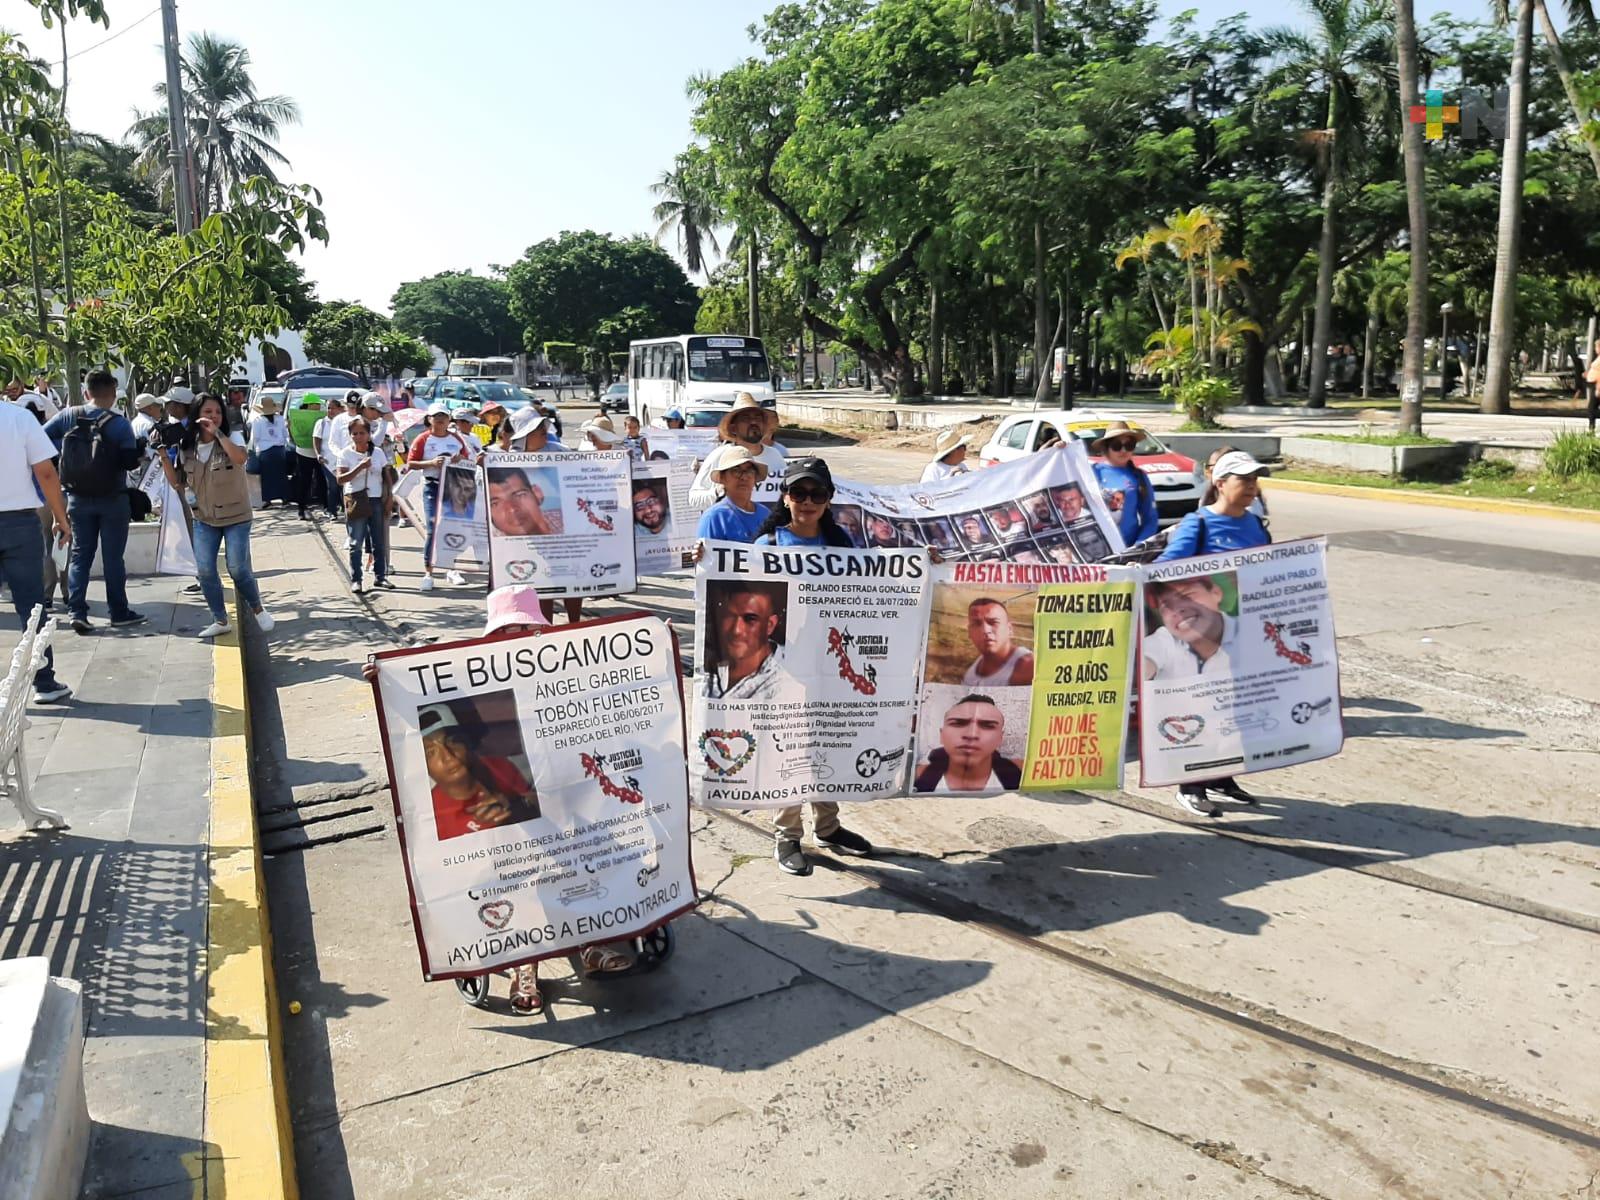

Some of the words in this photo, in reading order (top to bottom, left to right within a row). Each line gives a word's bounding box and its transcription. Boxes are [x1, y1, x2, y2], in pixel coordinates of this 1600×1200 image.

[713, 548, 749, 573] TE
[763, 552, 923, 578] BUSCAMOS
[954, 563, 1002, 582] HASTA
[1006, 564, 1108, 583] ENCONTRARTE
[1223, 559, 1231, 569] A
[1260, 573, 1285, 586] JUAN
[1287, 568, 1317, 581] PABLO
[798, 584, 840, 592] ORLANDO
[841, 584, 877, 593] ESTRADA
[1242, 587, 1282, 603] BADILLO
[798, 596, 861, 606] DESAPARECIÓ
[863, 597, 874, 605] EL
[1037, 594, 1083, 614] TOMAS
[1087, 593, 1133, 612] ELVIRA
[819, 610, 830, 618] EN
[855, 635, 883, 645] JUSTICIA
[1048, 628, 1114, 649] ESCAROLA
[409, 661, 457, 696] TE
[466, 628, 654, 688] BUSCAMOS
[535, 676, 586, 700] ÁNGEL
[589, 665, 652, 690] GABRIEL
[1055, 665, 1073, 684] 28
[1075, 661, 1109, 683] AÑOS
[534, 697, 590, 725] TOBÓN
[593, 685, 660, 713] FUENTES
[879, 700, 905, 708] ESCRIBE
[1098, 691, 1116, 704] VER
[535, 715, 601, 739] DESAPARECIÓ
[815, 719, 846, 728] Dignidad
[848, 720, 875, 728] Veracruz
[1048, 715, 1074, 737] ¡NO
[1077, 713, 1098, 734] ME
[555, 738, 567, 750] EN
[569, 732, 594, 747] BOCA
[595, 730, 613, 742] DEL
[818, 730, 857, 739] emergencia
[608, 748, 635, 762] JUSTICIA
[822, 741, 852, 749] anónima
[1039, 736, 1101, 758] OLVIDES,
[1032, 758, 1076, 780] FALTO
[1079, 757, 1103, 776] YO!
[707, 788, 789, 801] ¡AYÚDANOS
[790, 788, 798, 796] A
[443, 856, 453, 867] SI
[454, 854, 466, 865] LO
[467, 848, 485, 861] HAS
[487, 842, 513, 858] VISTO
[514, 842, 521, 852] O
[524, 834, 554, 850] TIENES
[555, 826, 587, 843] ALGUNA
[587, 811, 640, 834] INFORMACIÓN
[579, 847, 611, 863] Dignidad
[613, 837, 645, 854] Veracruz
[530, 869, 577, 889] emergencia
[447, 921, 556, 966] ¡AYÚDANOS
[560, 922, 574, 937] A
[577, 881, 681, 935] ENCONTRARLO!
